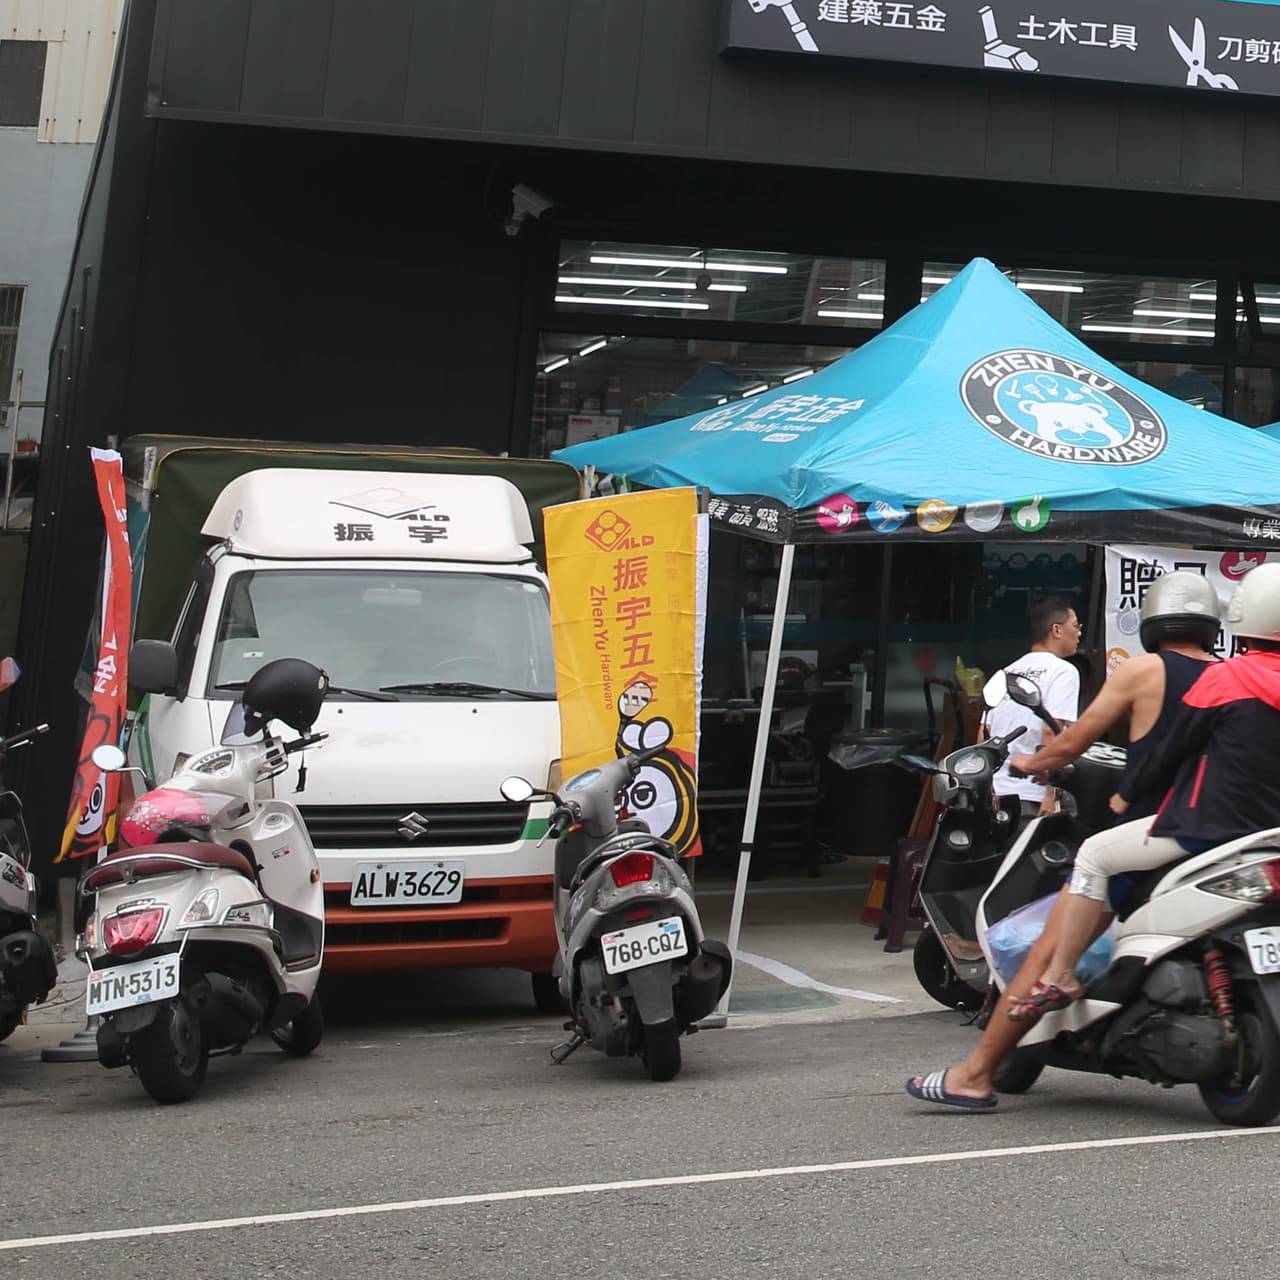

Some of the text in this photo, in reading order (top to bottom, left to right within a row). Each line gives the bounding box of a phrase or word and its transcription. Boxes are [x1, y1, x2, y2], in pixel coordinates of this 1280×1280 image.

[1018, 16, 1138, 52] 土木工具
[971, 353, 1115, 391] ZHEN YU
[1010, 428, 1161, 462] HARDWARE
[600, 653, 614, 711] Hardware
